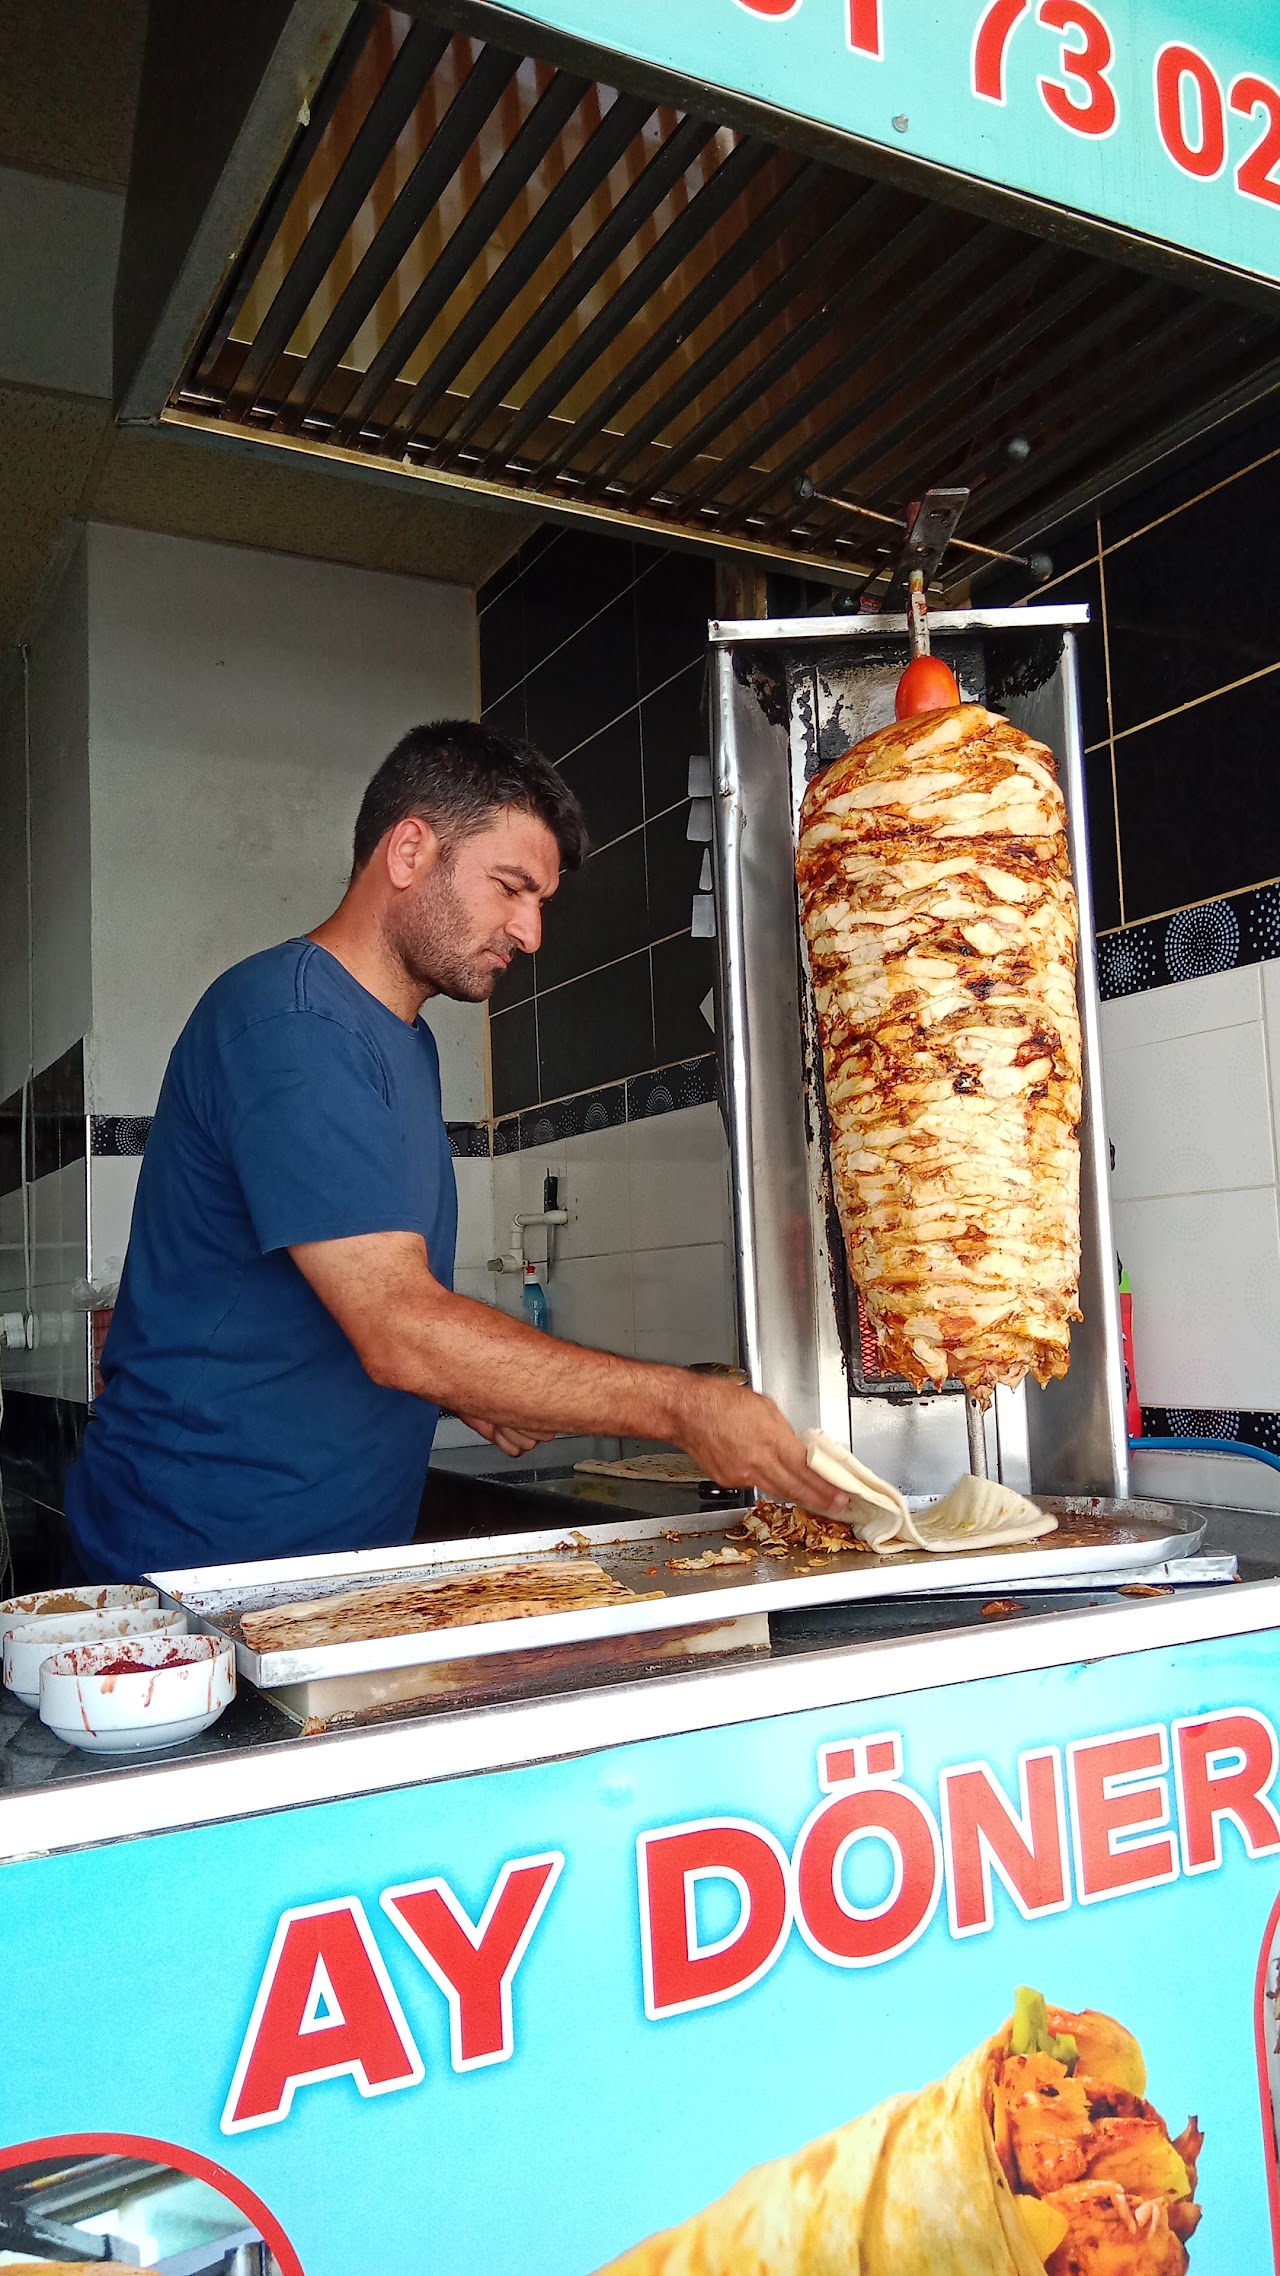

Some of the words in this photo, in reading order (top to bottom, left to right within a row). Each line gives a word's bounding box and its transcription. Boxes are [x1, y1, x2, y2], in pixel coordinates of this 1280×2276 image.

[1154, 41, 1280, 208] 02
[222, 1852, 563, 2134] AY
[637, 1707, 1280, 2021] DÖNER
